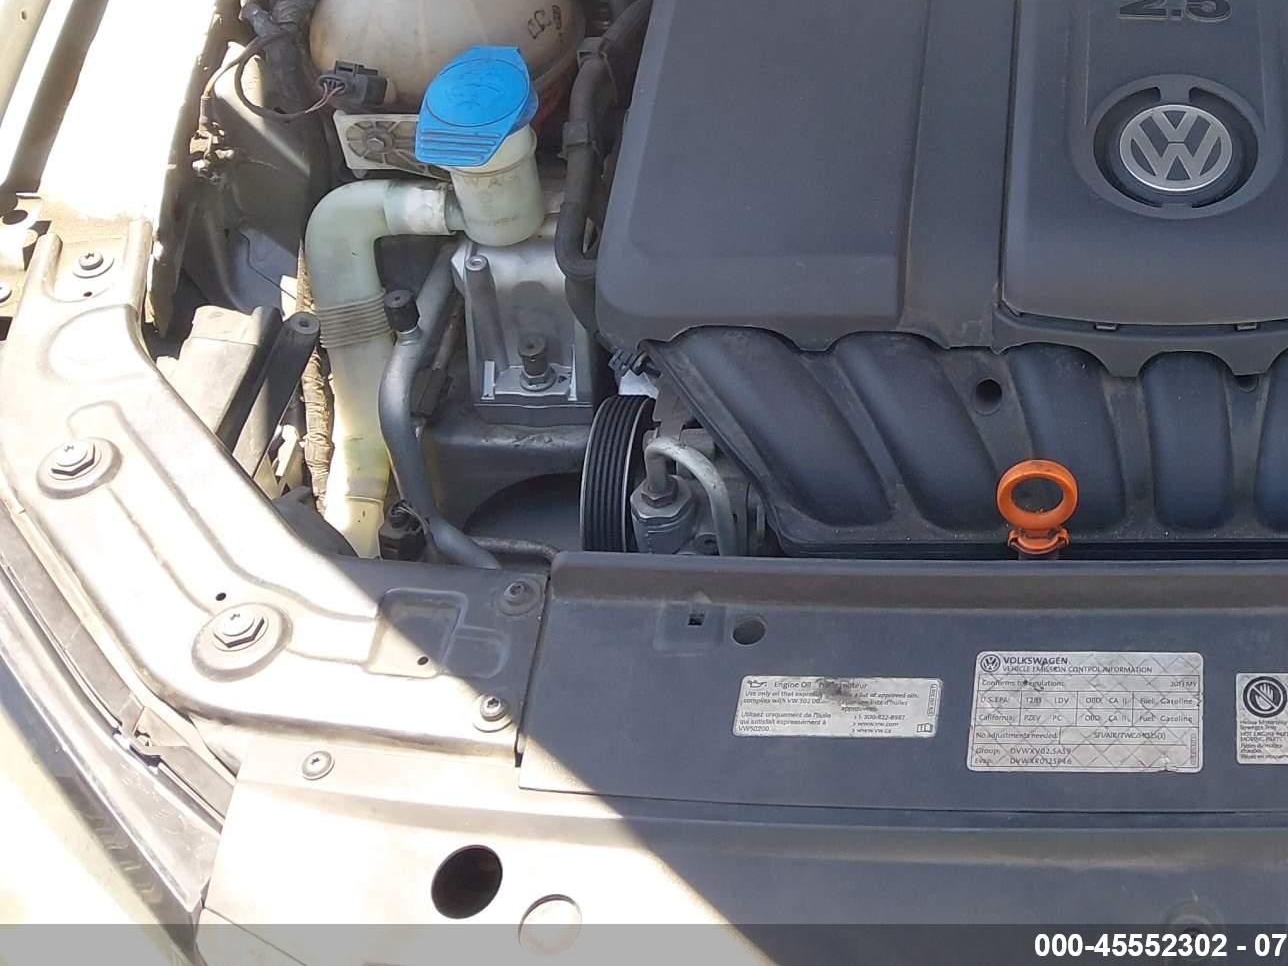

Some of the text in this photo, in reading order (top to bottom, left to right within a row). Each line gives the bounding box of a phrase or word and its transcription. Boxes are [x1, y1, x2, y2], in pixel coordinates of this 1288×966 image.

[1002, 657, 1068, 665] VOLKSWAGEN
[1002, 665, 1153, 674] VEHICLE EMISSION CONTROL INFORMATION
[774, 681, 799, 690] Engine
[1025, 679, 1065, 688] egulations
[1160, 697, 1193, 705] Gasoline
[987, 732, 1030, 740] adjustments
